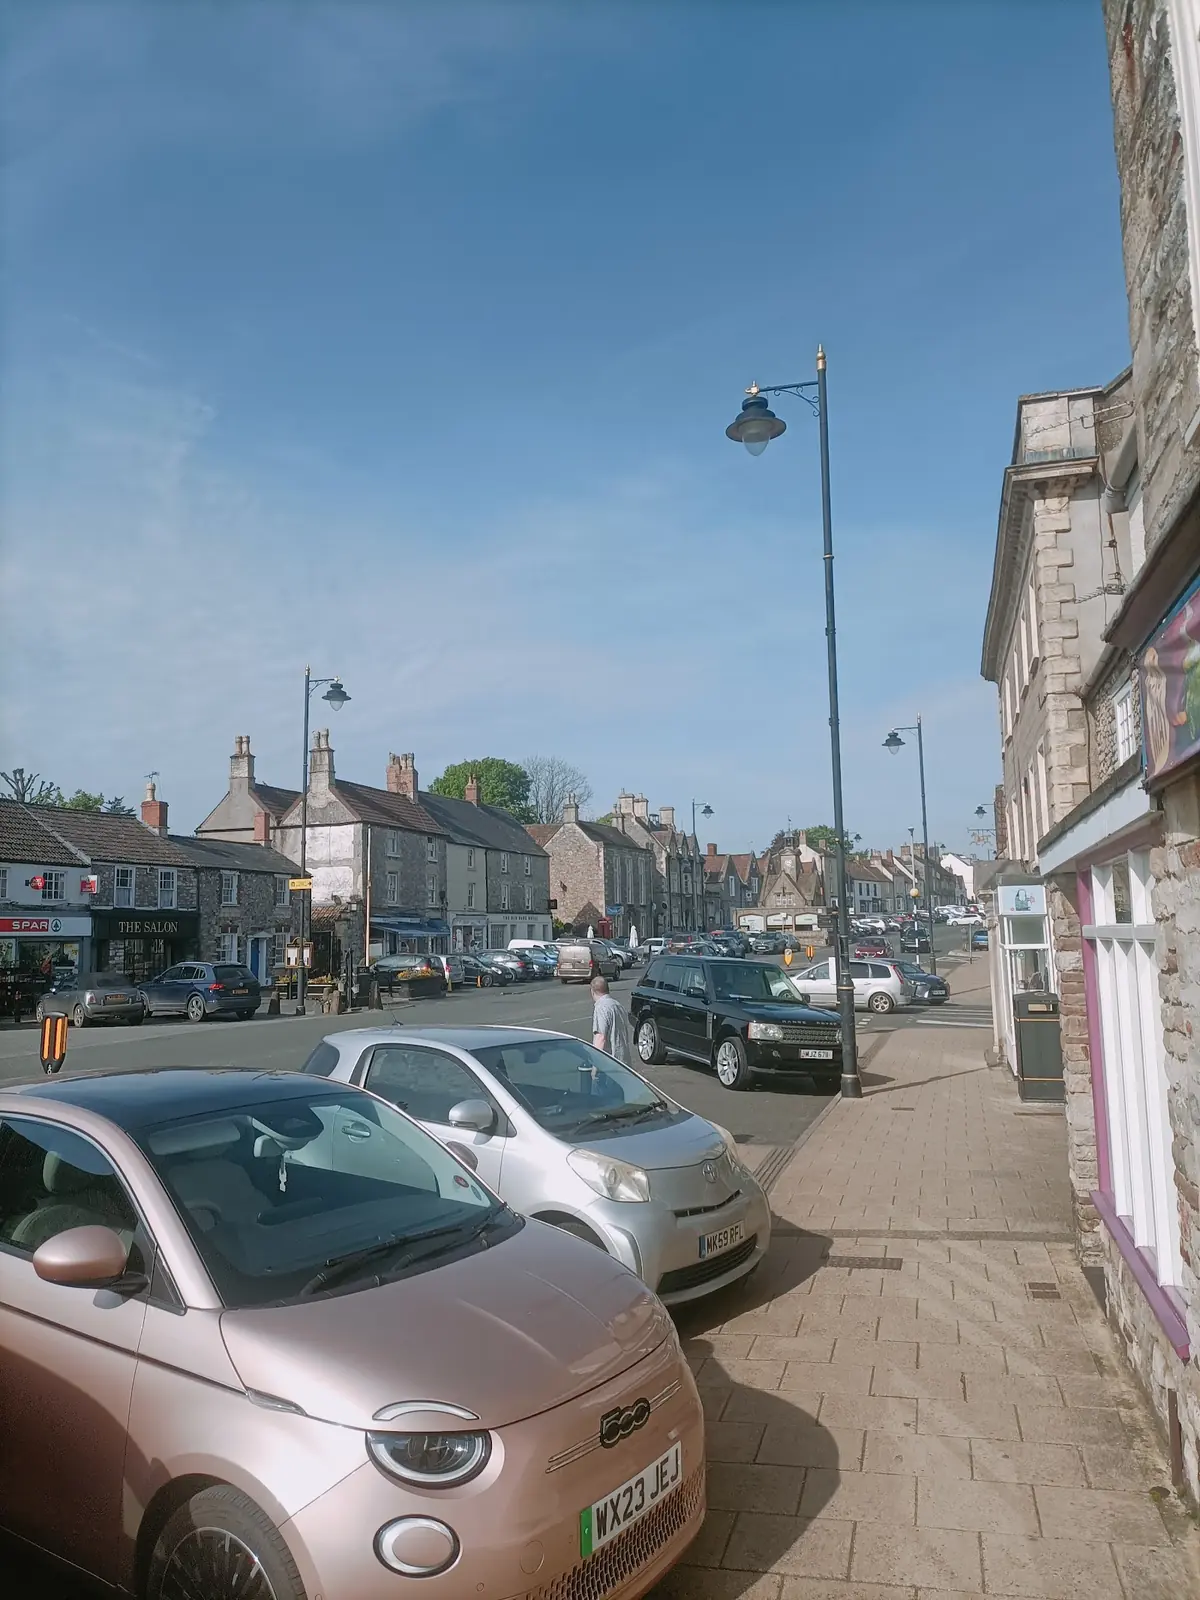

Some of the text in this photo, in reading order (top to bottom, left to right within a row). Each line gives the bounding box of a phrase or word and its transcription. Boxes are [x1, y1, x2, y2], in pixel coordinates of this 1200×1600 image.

[12, 921, 48, 930] SPAR
[118, 921, 178, 933] THE SALON
[706, 1230, 728, 1254] MK59
[602, 1400, 649, 1445] 500
[596, 1448, 679, 1540] WX23 JEJ
